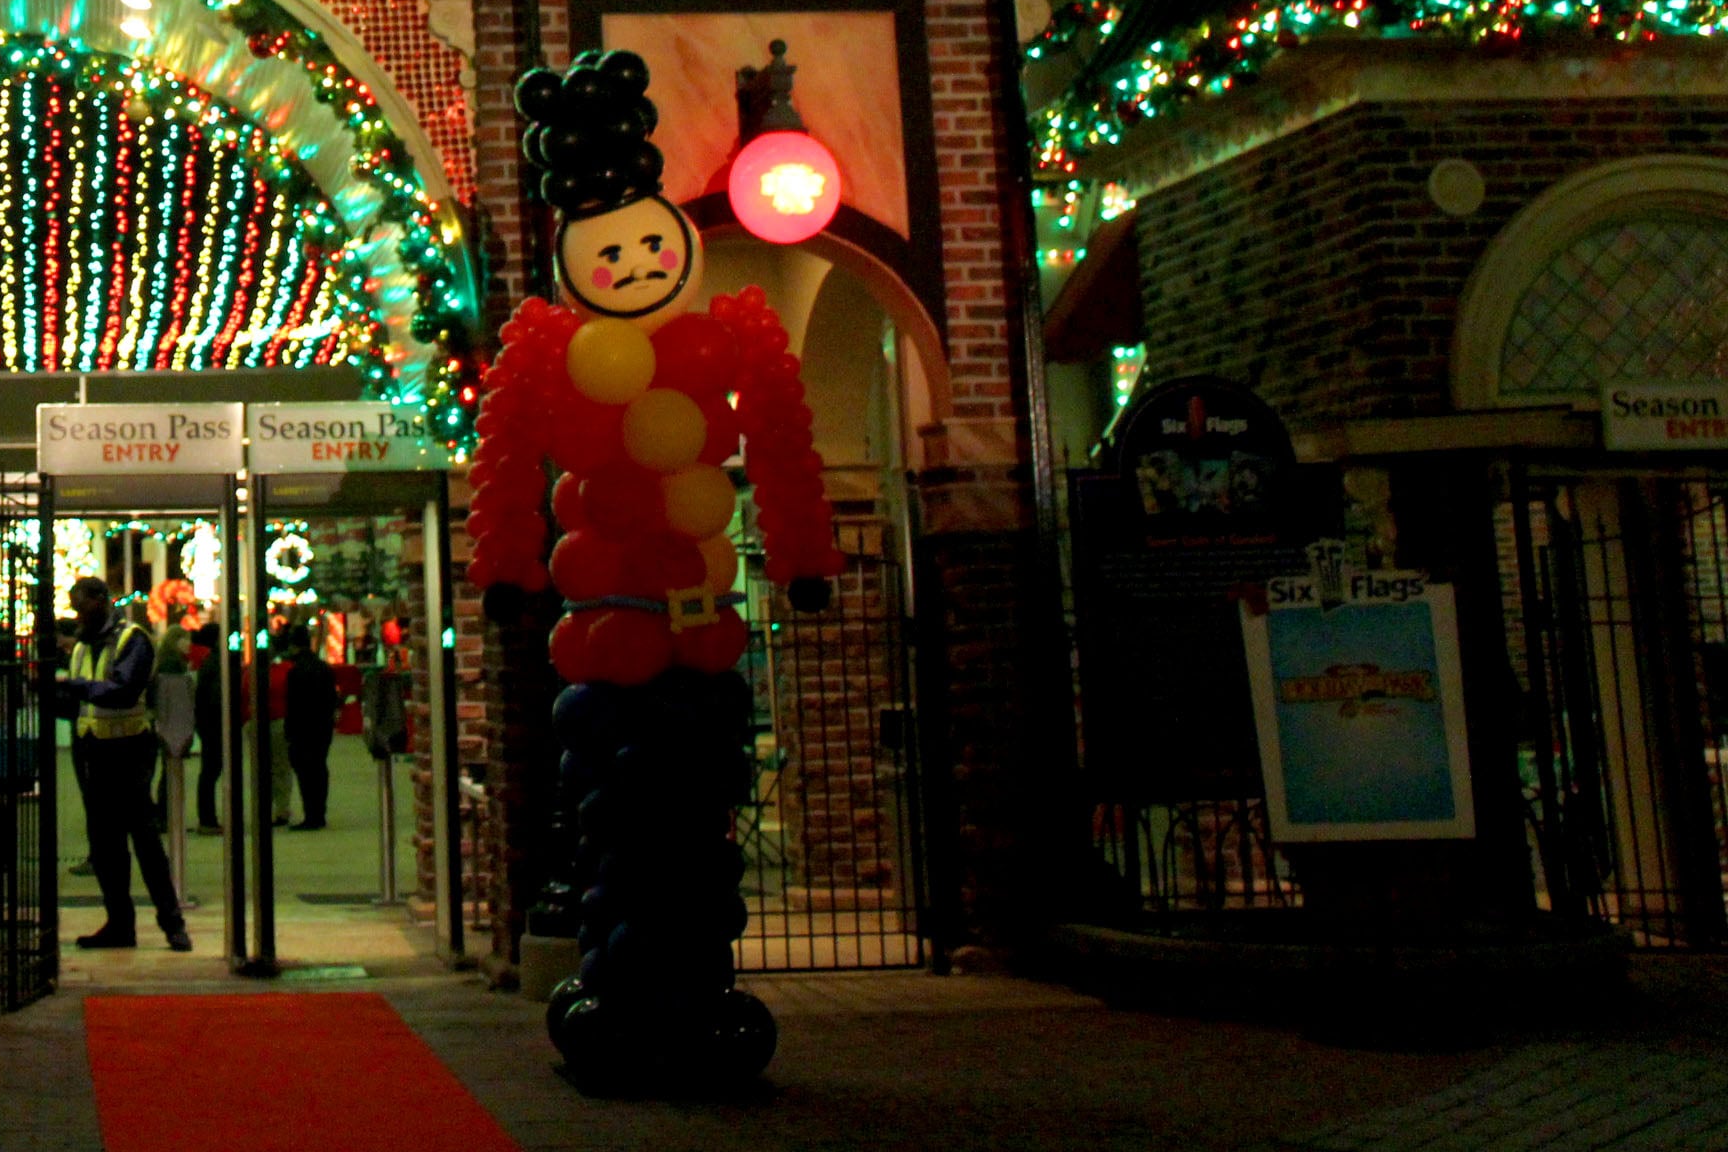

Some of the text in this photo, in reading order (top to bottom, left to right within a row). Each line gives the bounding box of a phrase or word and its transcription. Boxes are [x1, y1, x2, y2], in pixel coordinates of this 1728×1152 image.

[1613, 391, 1719, 418] Season
[49, 414, 232, 441] Season Pass
[258, 413, 425, 439] Season Pas
[1666, 418, 1728, 439] ENTR
[102, 442, 180, 463] ENTRY
[312, 441, 389, 462] ENTRY
[1271, 575, 1424, 603] Six Flags
